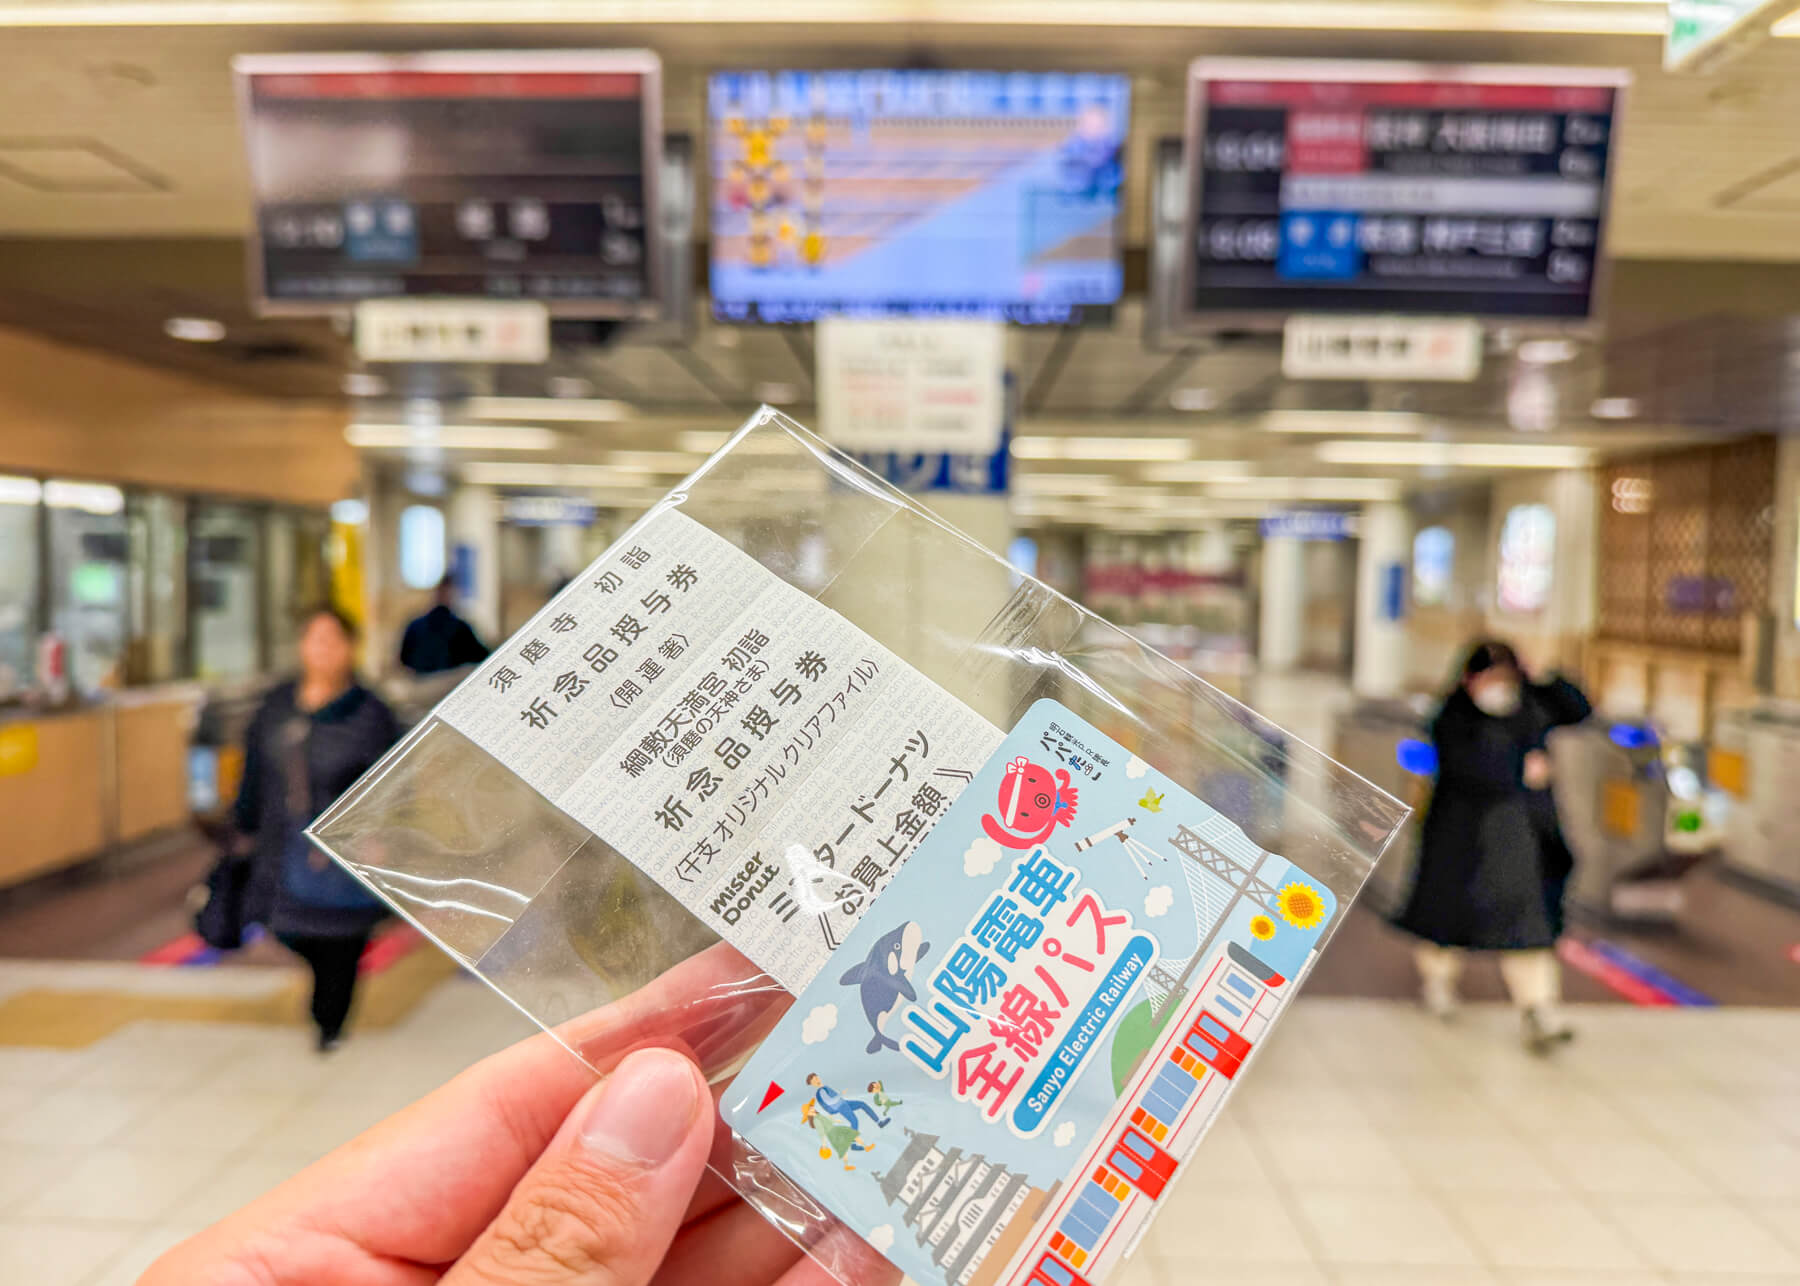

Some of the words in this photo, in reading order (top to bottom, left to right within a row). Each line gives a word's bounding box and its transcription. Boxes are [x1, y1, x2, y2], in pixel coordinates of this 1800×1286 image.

[488, 612, 578, 693] 須磨寺
[594, 545, 651, 595] 初詣
[520, 563, 699, 730] 祈念品授与券
[655, 650, 828, 833] 祈念品授与券
[722, 864, 780, 925] Donut
[905, 853, 1074, 1072] 山陽電車
[957, 894, 1126, 1118] 全線パス
[1027, 1063, 1066, 1113] Sanyo
[1058, 1005, 1103, 1066] Electric
[1098, 953, 1142, 1012] Railway
